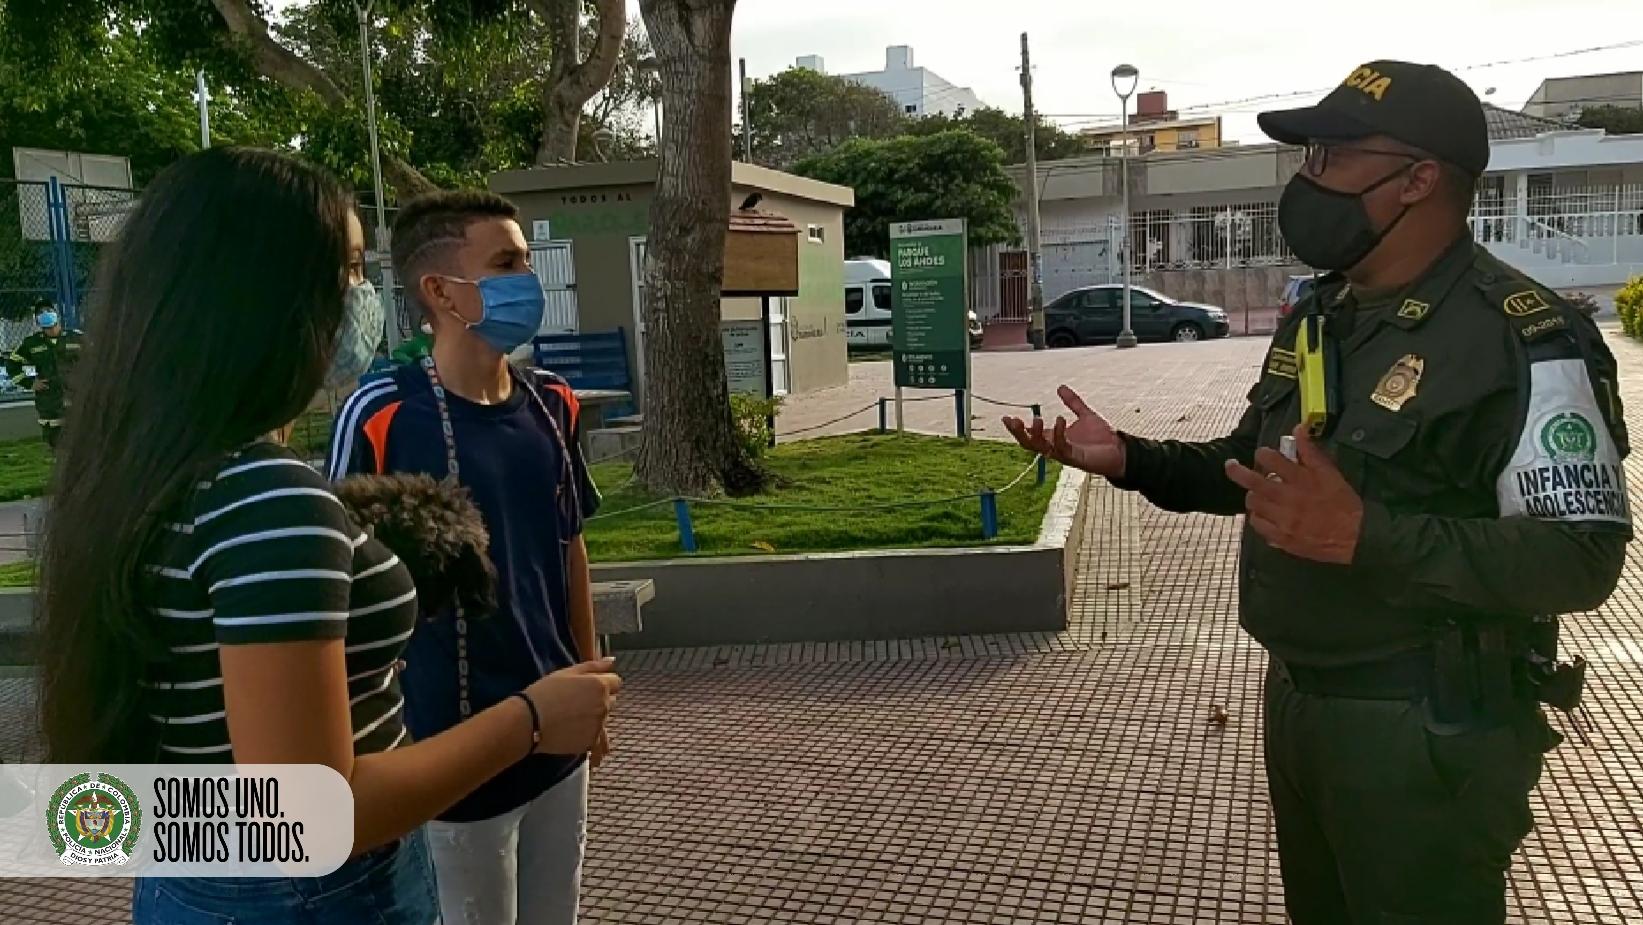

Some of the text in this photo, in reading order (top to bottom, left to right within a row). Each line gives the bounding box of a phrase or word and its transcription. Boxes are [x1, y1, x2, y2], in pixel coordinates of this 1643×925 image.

[898, 246, 929, 257] PARQUE
[898, 255, 945, 268] LOS ANDES
[1516, 464, 1612, 497] INFANCIA
